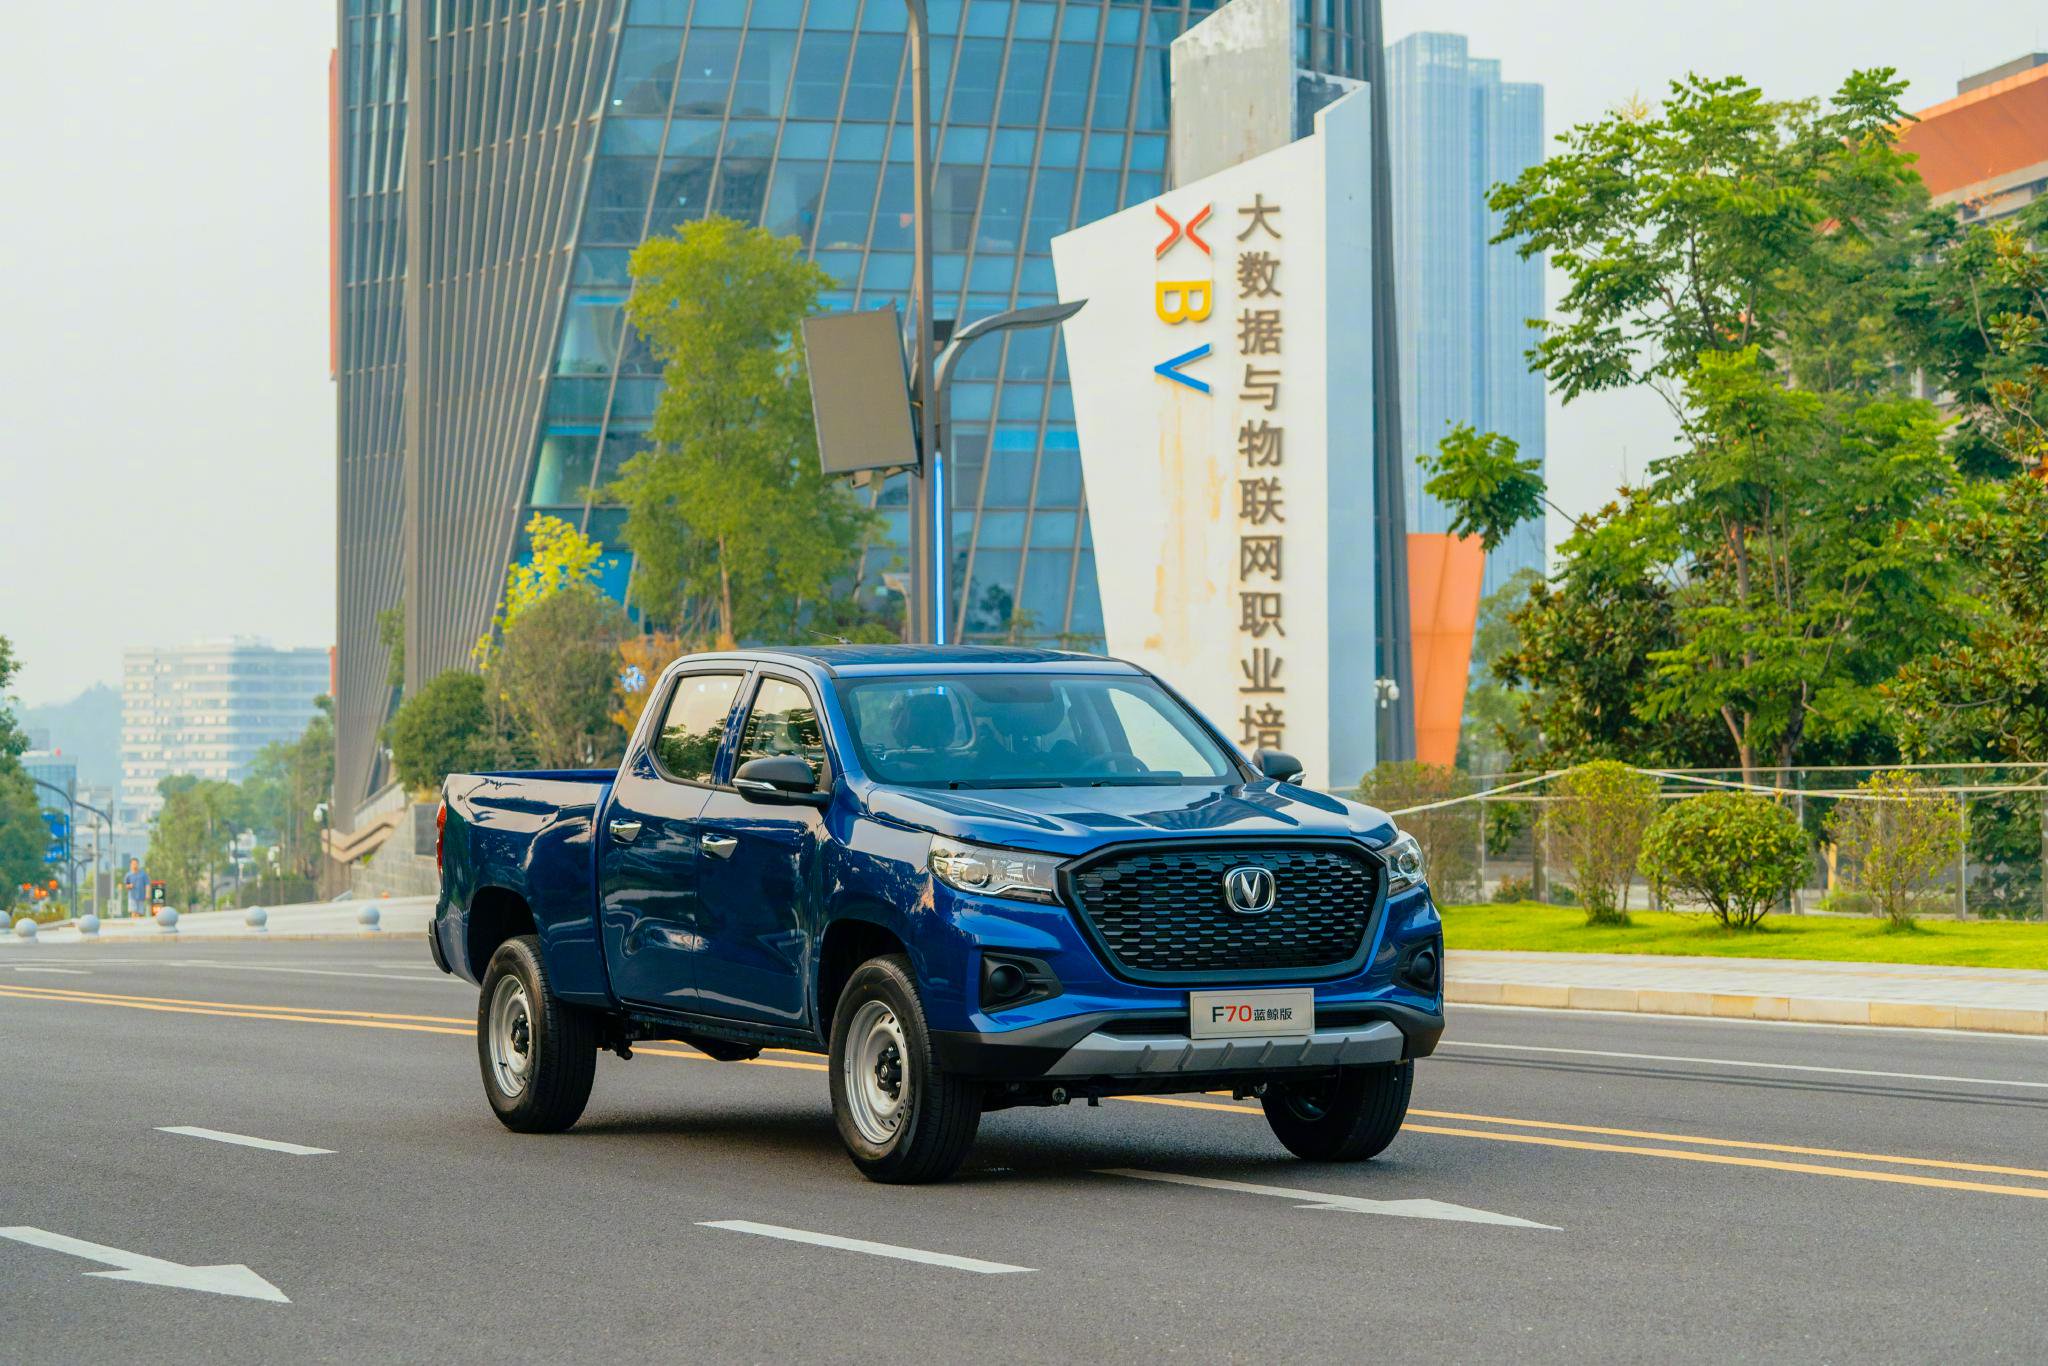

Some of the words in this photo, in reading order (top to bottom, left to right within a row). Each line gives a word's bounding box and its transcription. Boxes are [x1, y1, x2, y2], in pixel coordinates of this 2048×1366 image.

[1237, 194, 1286, 750] 大数据与物联网职业培
